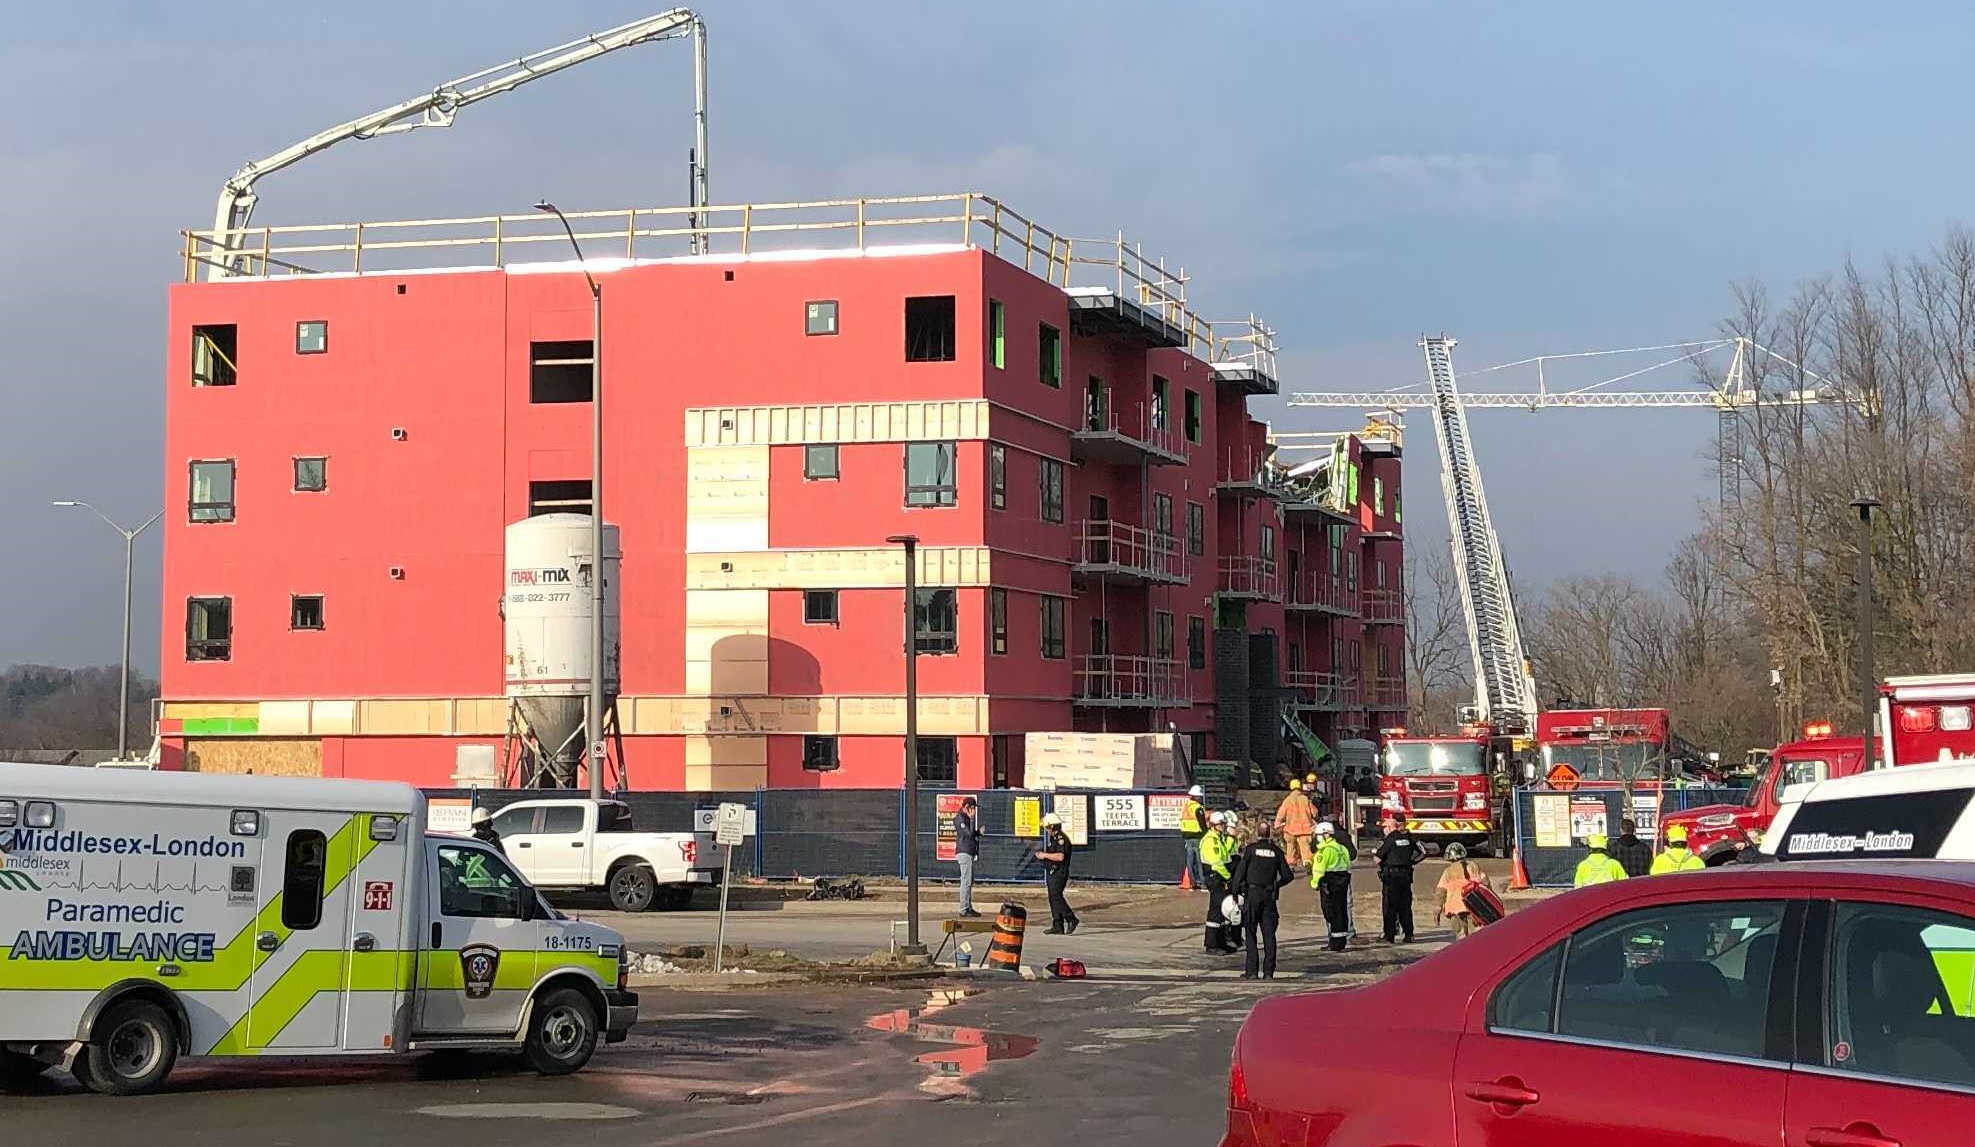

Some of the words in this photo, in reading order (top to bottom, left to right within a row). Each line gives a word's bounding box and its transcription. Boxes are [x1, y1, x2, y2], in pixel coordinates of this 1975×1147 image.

[537, 666, 548, 674] 61
[1106, 799, 1133, 810] 555
[13, 829, 245, 857] Middlesex-London
[1789, 830, 1913, 853] Middlesex-London
[6, 855, 70, 869] middlesex
[365, 892, 392, 908] 9-1-1
[46, 898, 185, 924] Paramedic
[8, 930, 215, 962] AMBULANCE
[544, 936, 592, 949] 18-1175
